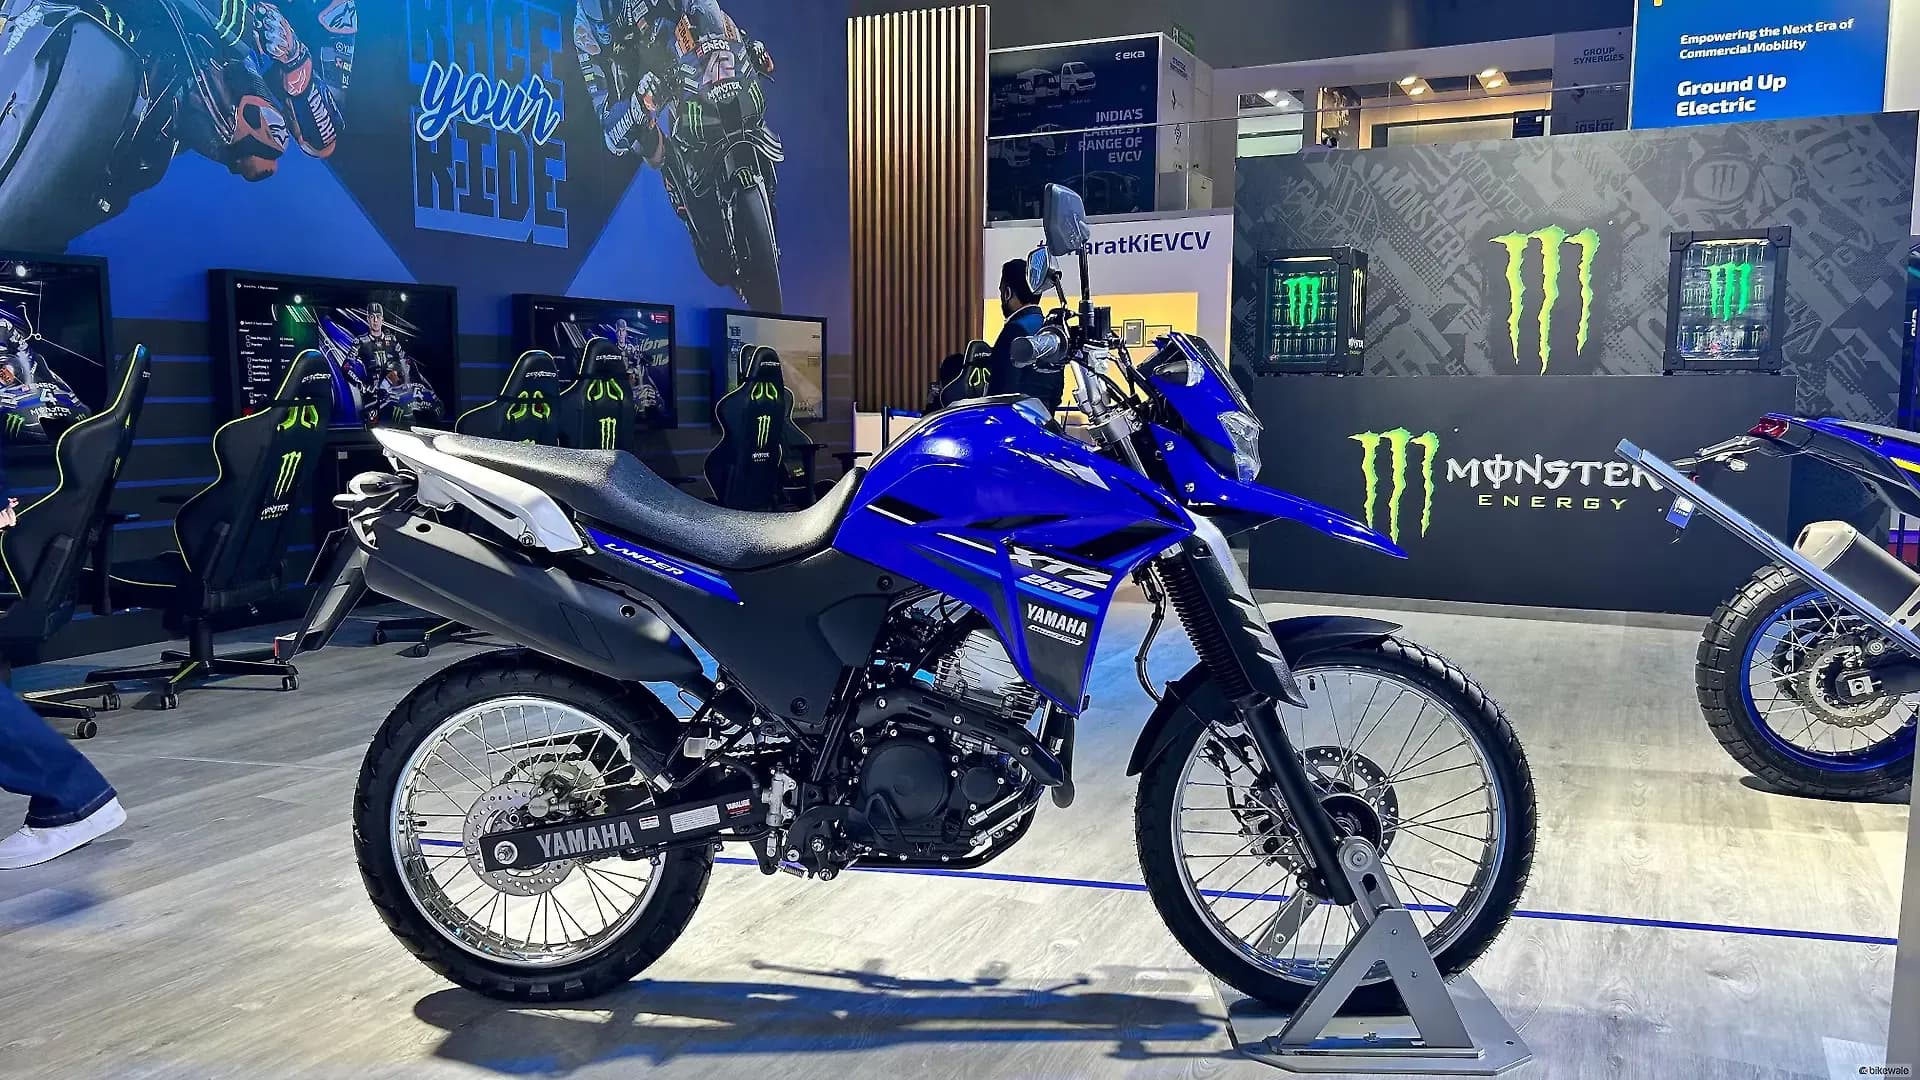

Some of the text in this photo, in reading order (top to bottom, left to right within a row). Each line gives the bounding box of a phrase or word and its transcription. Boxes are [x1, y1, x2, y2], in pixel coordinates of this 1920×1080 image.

[1680, 17, 1855, 45] Empowering the Next Era of
[1573, 53, 1625, 65] SYNERGIES
[1583, 47, 1615, 57] GROUP
[1679, 39, 1807, 60] Commercial Mobility
[1677, 73, 1787, 97] Ground Up
[416, 60, 561, 146] your
[1095, 108, 1144, 123] INDIA'S
[1675, 96, 1757, 117] Electric
[1078, 136, 1143, 152] RANGE OF
[1108, 150, 1143, 163] EVCV
[413, 107, 568, 240] RIDE
[1446, 453, 1664, 491] MONSTER
[1478, 494, 1629, 512] ENERGY
[603, 542, 685, 576] LANDER
[1008, 546, 1114, 590] XTZ
[1019, 573, 1095, 600] 250
[1027, 603, 1088, 638] YAMAHA
[535, 821, 635, 858] YAMAHA
